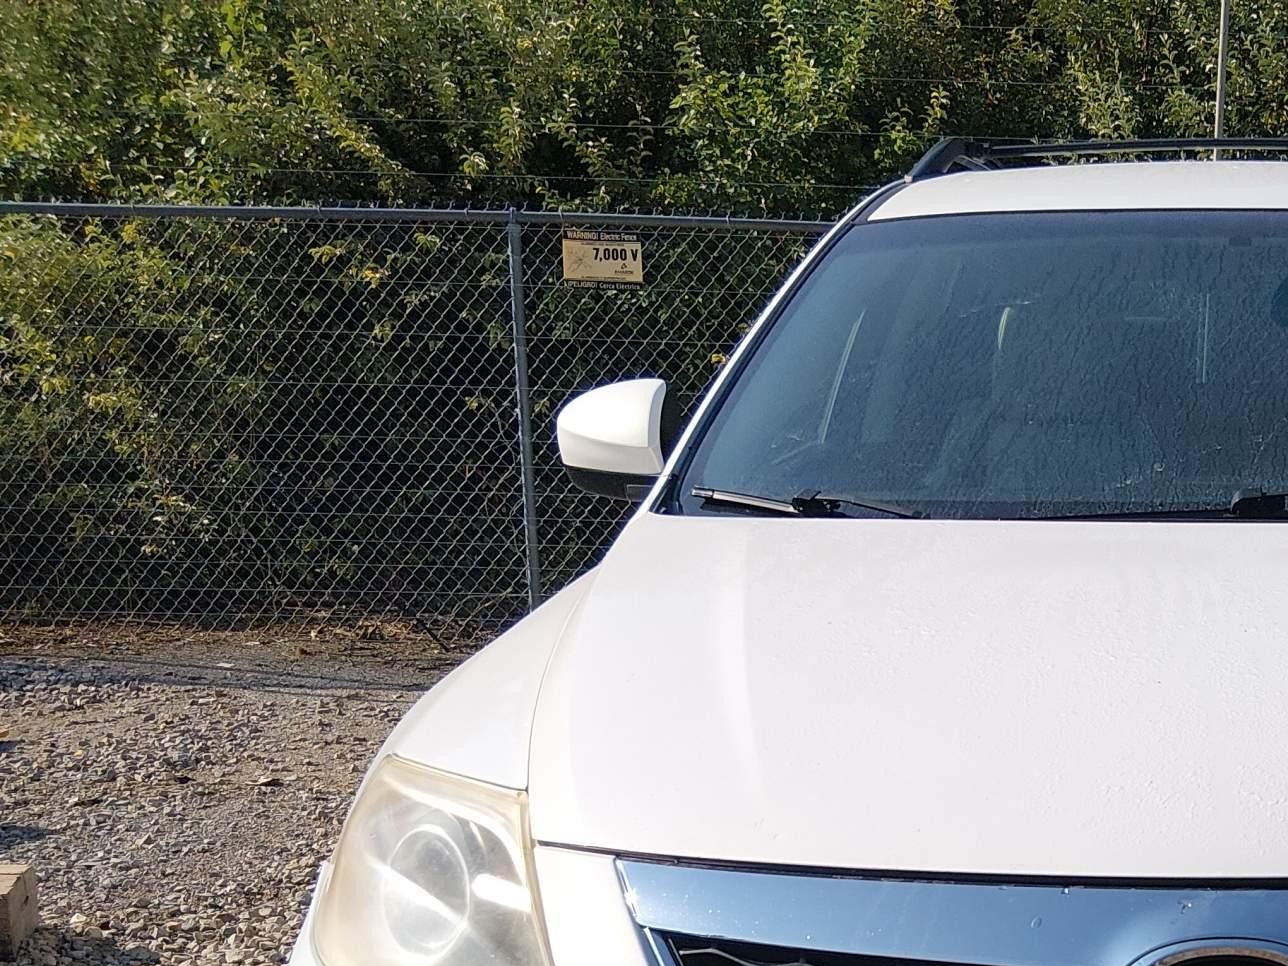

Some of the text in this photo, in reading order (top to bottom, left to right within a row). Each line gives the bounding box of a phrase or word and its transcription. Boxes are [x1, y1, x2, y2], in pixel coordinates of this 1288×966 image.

[600, 232, 620, 241] Electric
[621, 233, 637, 241] Fence
[592, 247, 639, 261] 7,000 V
